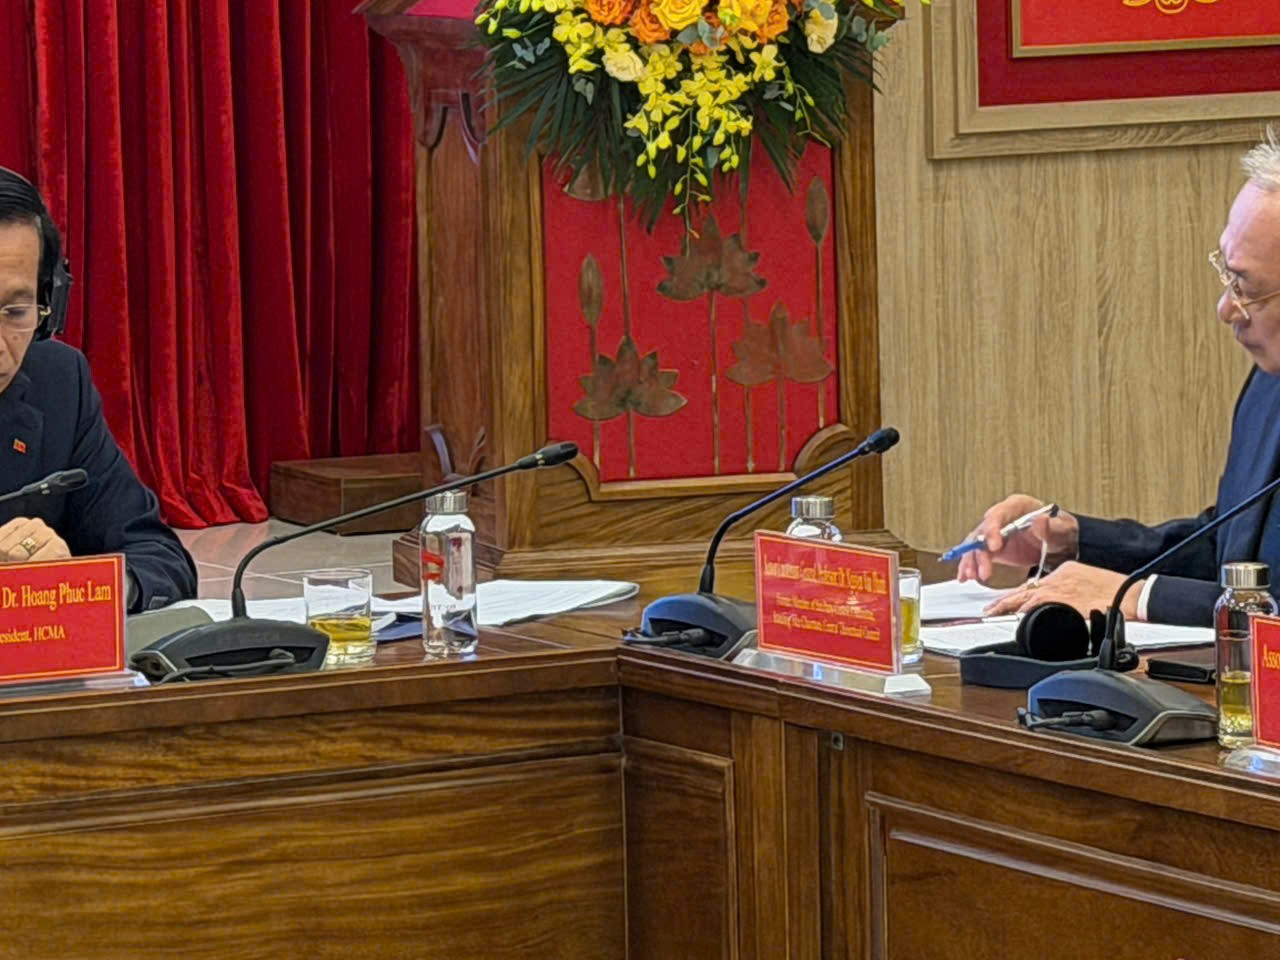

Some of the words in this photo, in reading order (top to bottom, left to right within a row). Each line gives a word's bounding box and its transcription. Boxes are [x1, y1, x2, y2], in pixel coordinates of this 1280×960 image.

[2, 587, 19, 609] Dr.
[21, 584, 57, 611] Hoang
[59, 581, 85, 605] Phuc
[87, 580, 112, 602] Lam
[34, 624, 66, 641] HCMA
